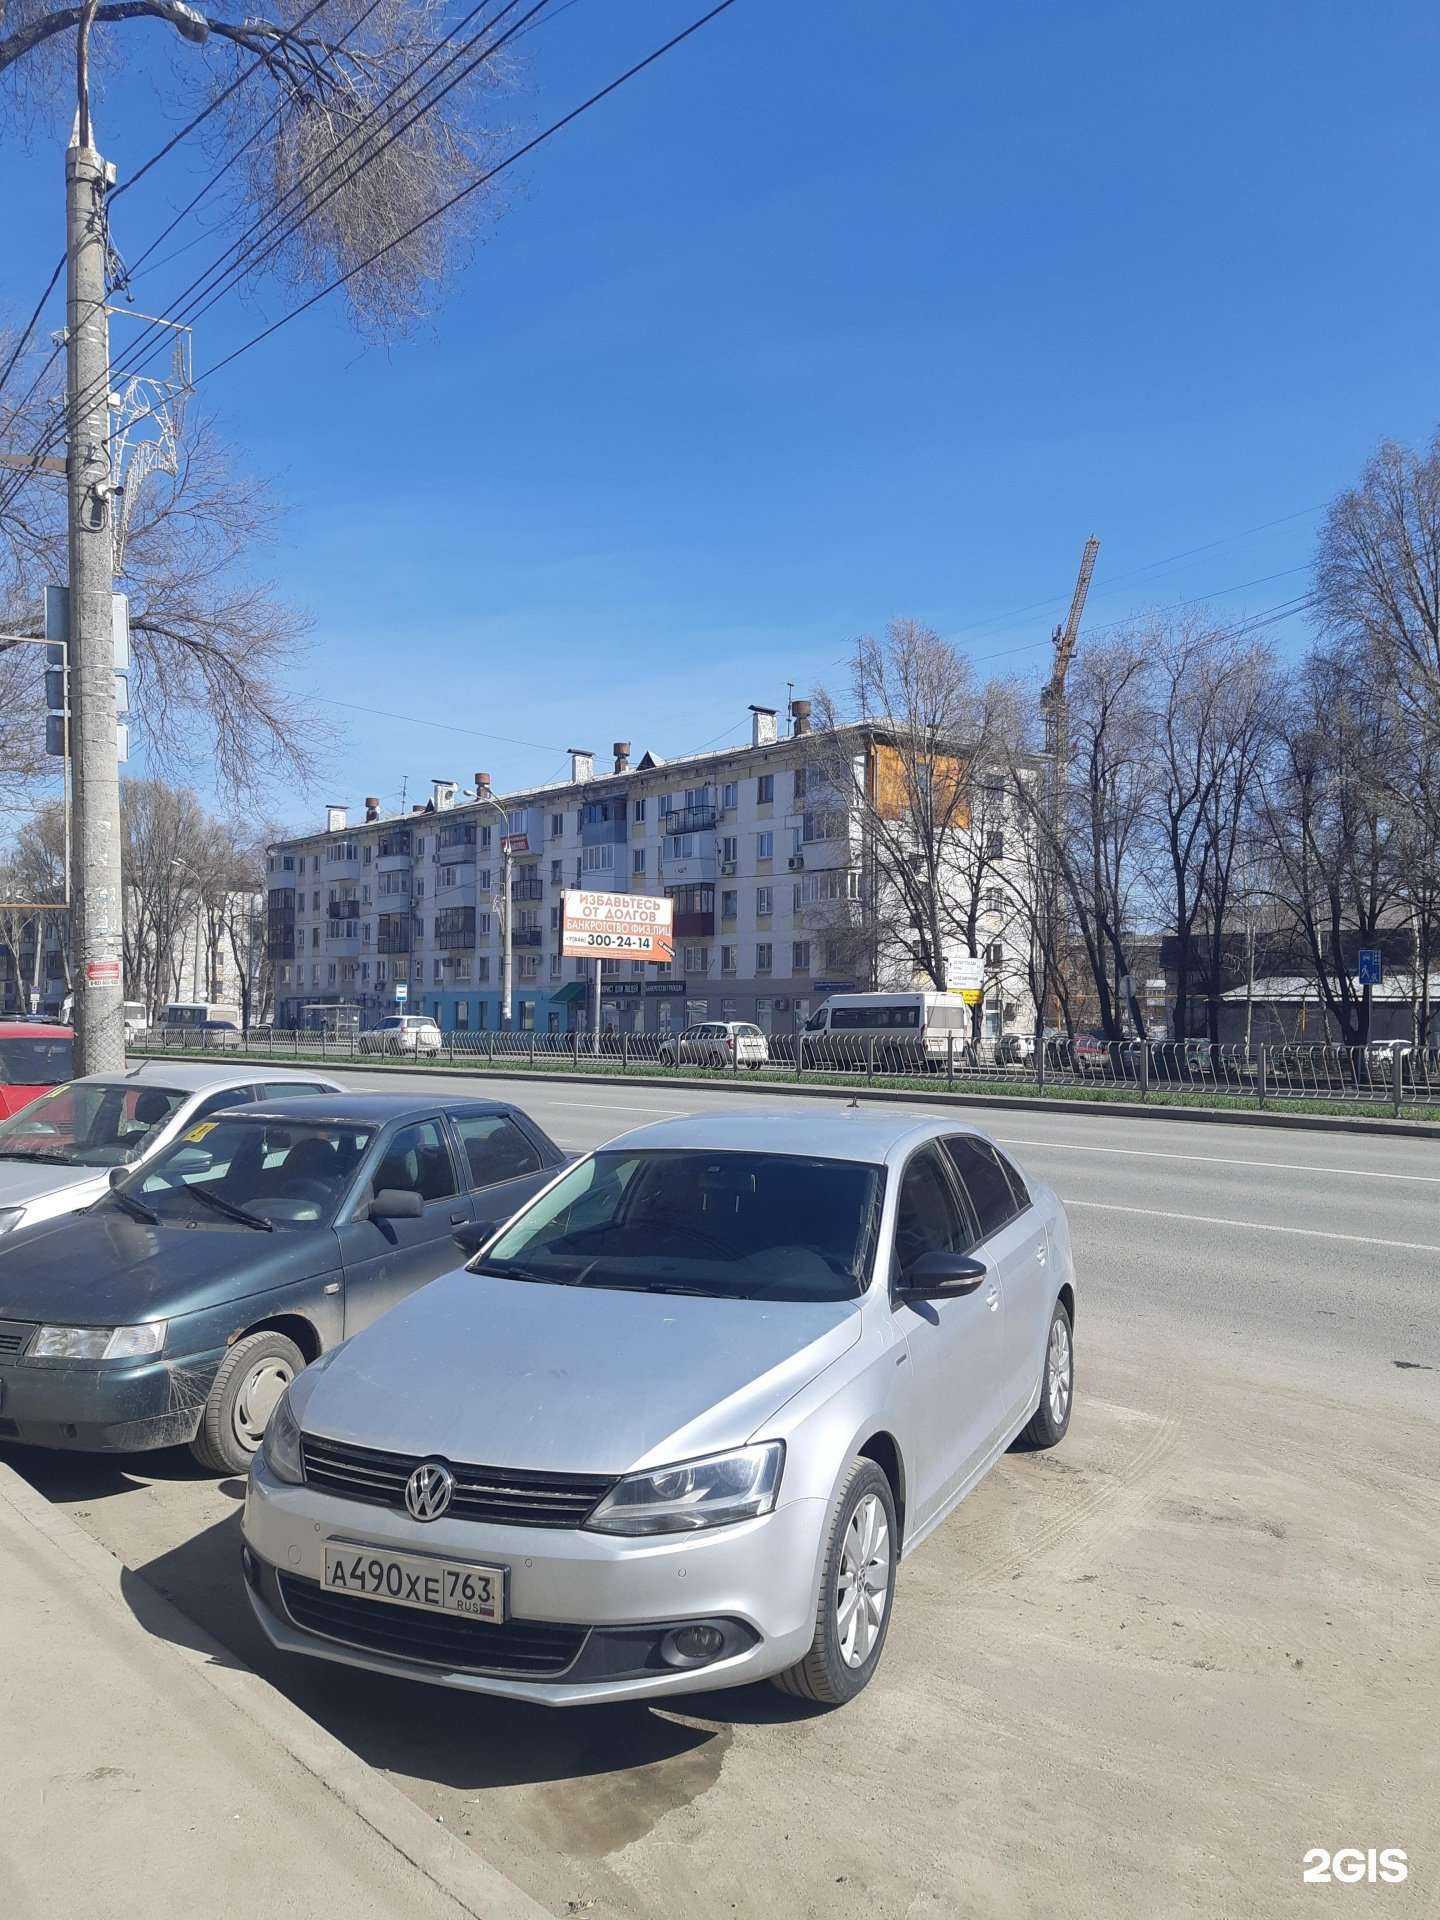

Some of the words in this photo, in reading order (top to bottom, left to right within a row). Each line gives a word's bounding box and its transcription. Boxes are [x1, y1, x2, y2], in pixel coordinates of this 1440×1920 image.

[580, 894, 660, 911] ИЗБАВЬТЕСЬ
[583, 906, 599, 917] ОТ
[605, 908, 657, 922] ДОЛГОВ
[567, 919, 631, 934] БАНКРОТСТВО
[588, 934, 651, 949] 300-24-14
[447, 1571, 491, 1603] 763
[457, 1600, 480, 1614] RUS
